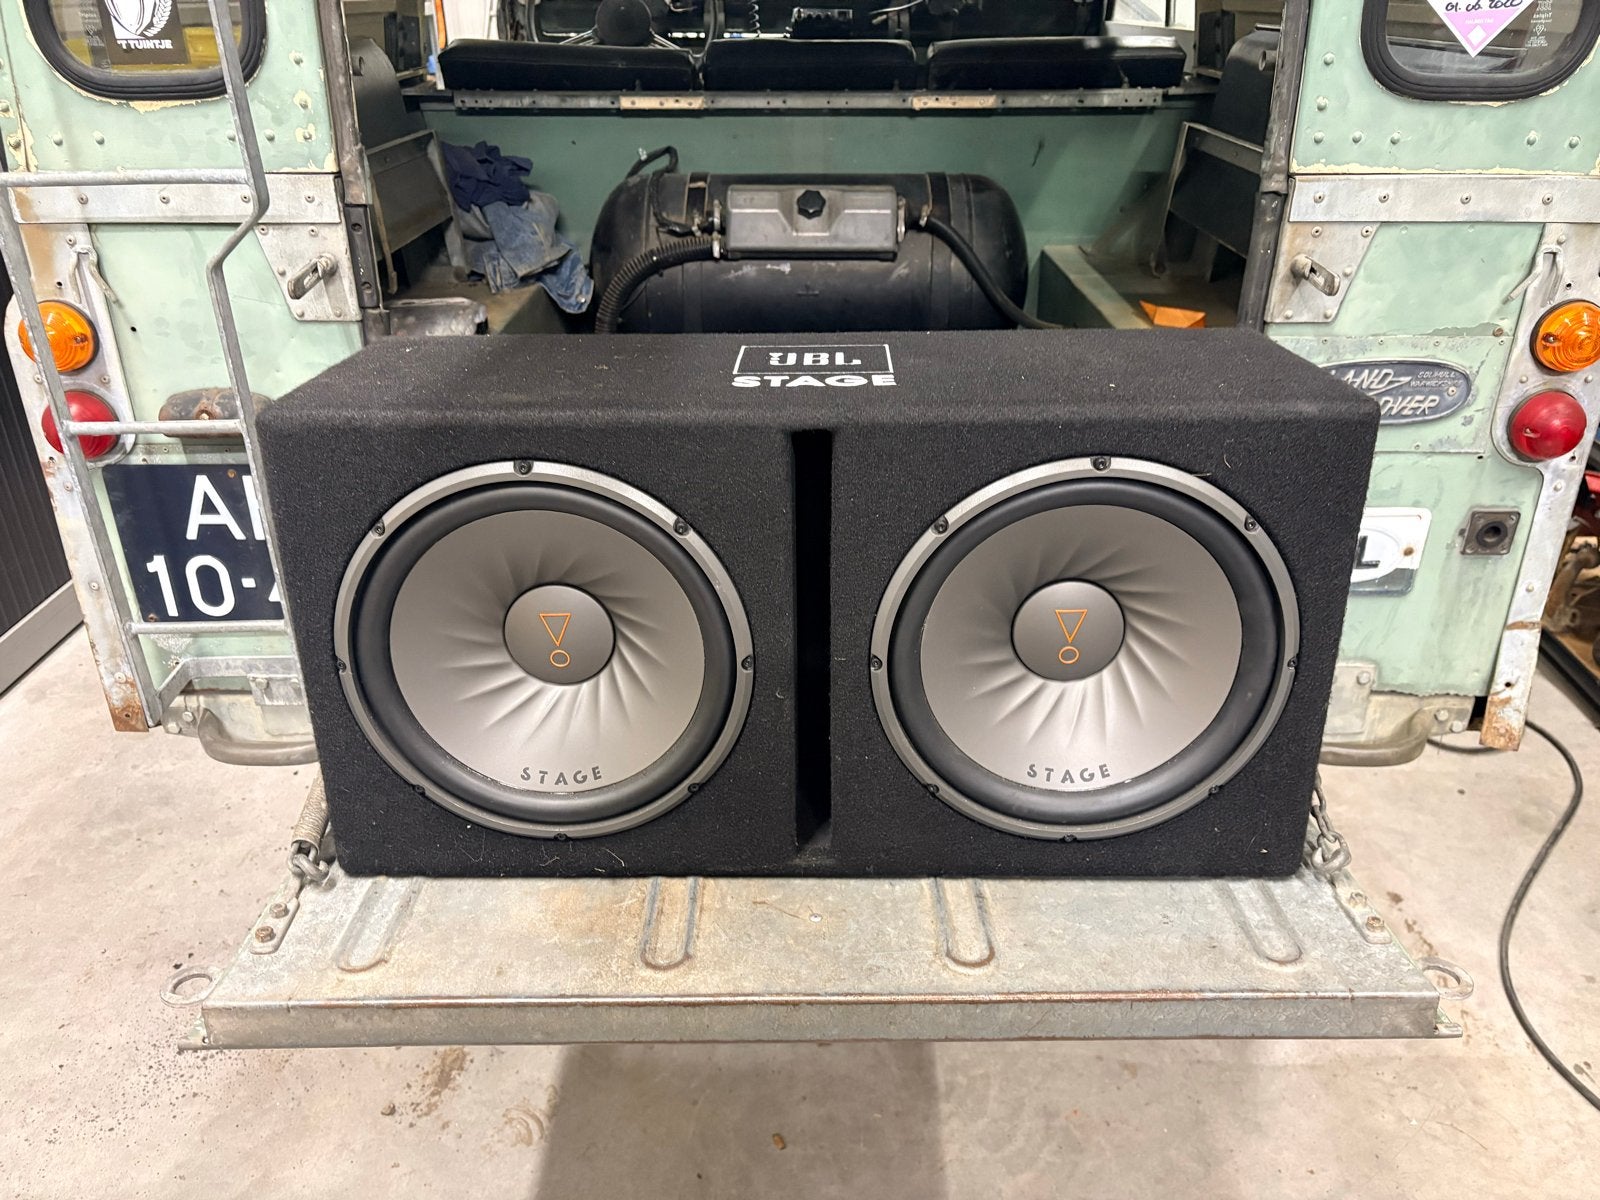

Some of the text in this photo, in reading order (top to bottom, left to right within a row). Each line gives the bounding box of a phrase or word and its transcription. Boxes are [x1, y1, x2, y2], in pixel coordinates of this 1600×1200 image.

[128, 40, 173, 49] TUINTJE
[769, 352, 862, 366] JBL
[731, 375, 897, 387] STAGE
[1380, 395, 1440, 416] OVER
[520, 766, 602, 785] STAGE
[1027, 764, 1111, 783] STAGE
